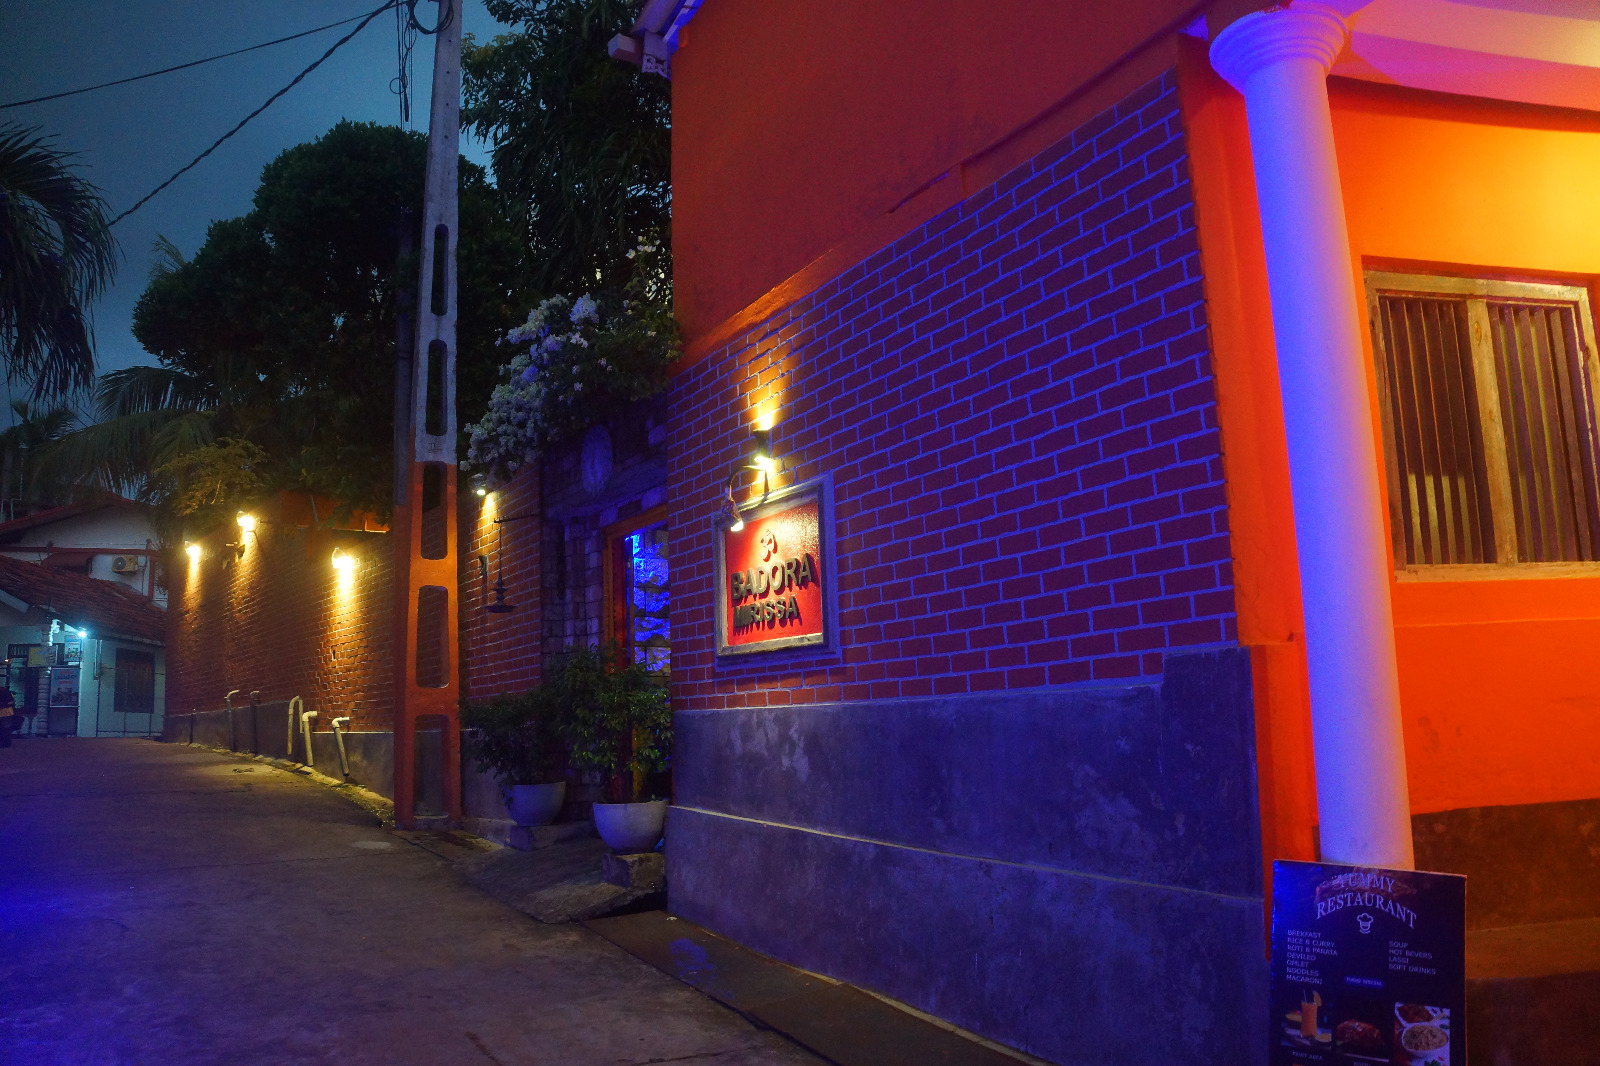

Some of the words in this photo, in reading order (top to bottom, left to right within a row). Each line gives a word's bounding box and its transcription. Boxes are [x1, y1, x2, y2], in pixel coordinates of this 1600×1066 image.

[731, 553, 812, 600] BADORA
[733, 596, 798, 628] MIRISSA
[1338, 872, 1395, 893] YUMMY
[1316, 892, 1417, 930] RESTAURANT
[1312, 940, 1335, 948] CURRY
[1388, 940, 1408, 948] SOUP
[1287, 944, 1303, 952] ROTI
[1312, 947, 1338, 956] PARATA
[1286, 952, 1317, 961] DEVILED
[1388, 956, 1409, 964] LASSI
[1286, 959, 1310, 968] OMLET
[1388, 963, 1407, 971] SOFT
[1409, 966, 1437, 975] DRINKS
[1286, 967, 1319, 977] NOODLES
[1286, 974, 1323, 985] MACARONI
